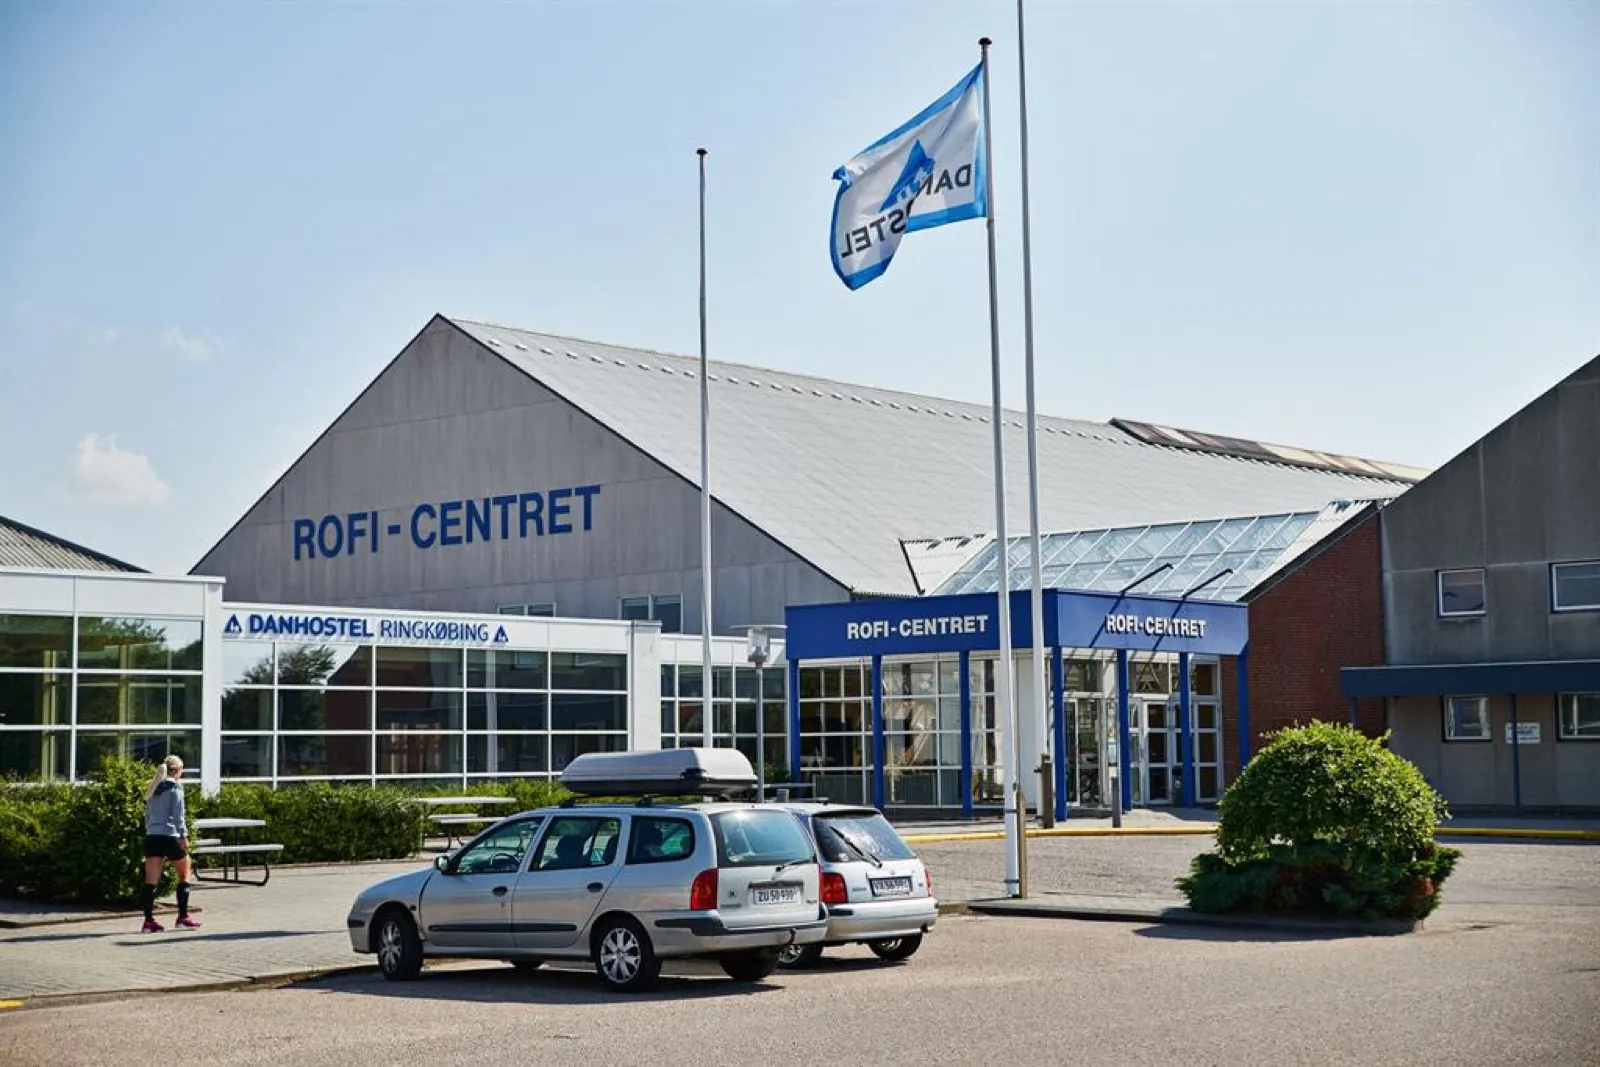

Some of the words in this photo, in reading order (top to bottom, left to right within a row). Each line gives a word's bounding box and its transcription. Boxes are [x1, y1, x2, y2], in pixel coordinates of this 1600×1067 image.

[250, 614, 374, 638] DANHOSTEL
[380, 619, 489, 641] RINGKØBING
[847, 615, 989, 640] ROFI-CENTRET
[1106, 614, 1207, 638] ROFI-CENTRET
